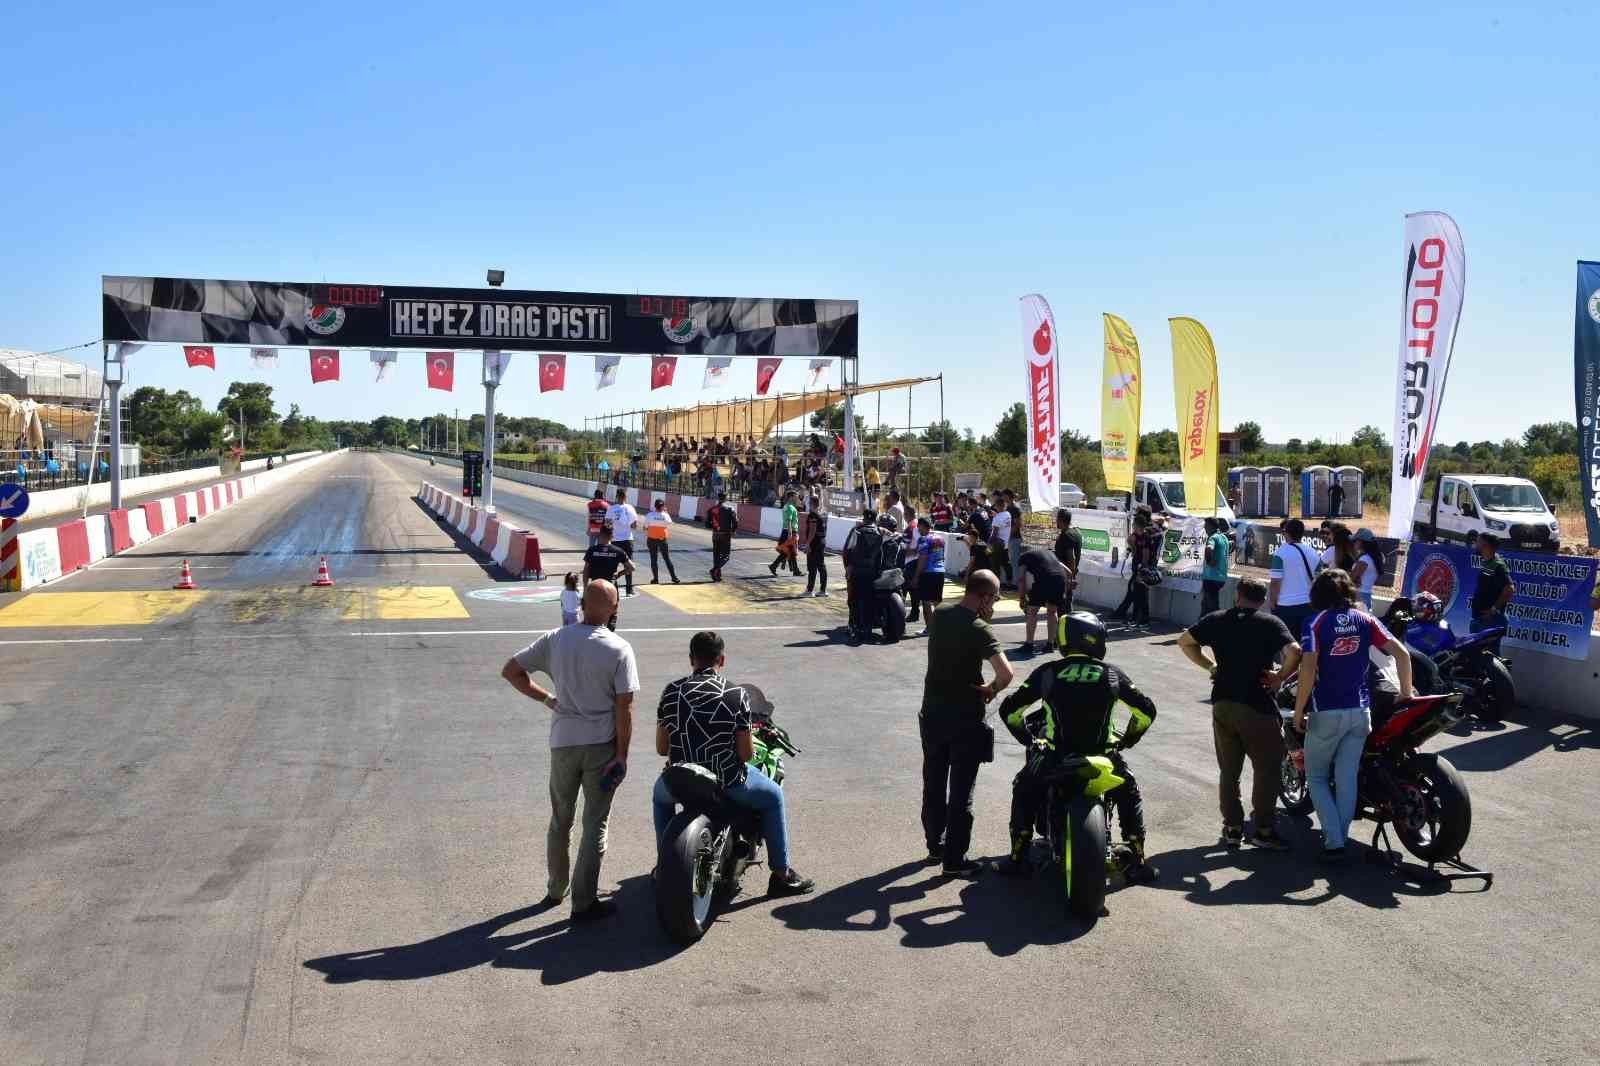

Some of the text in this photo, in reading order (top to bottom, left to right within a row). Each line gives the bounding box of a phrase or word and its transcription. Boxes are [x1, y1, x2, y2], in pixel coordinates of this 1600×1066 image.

[395, 302, 474, 335] KEPEZ
[480, 304, 541, 337] DRAG
[1056, 662, 1104, 683] 46
